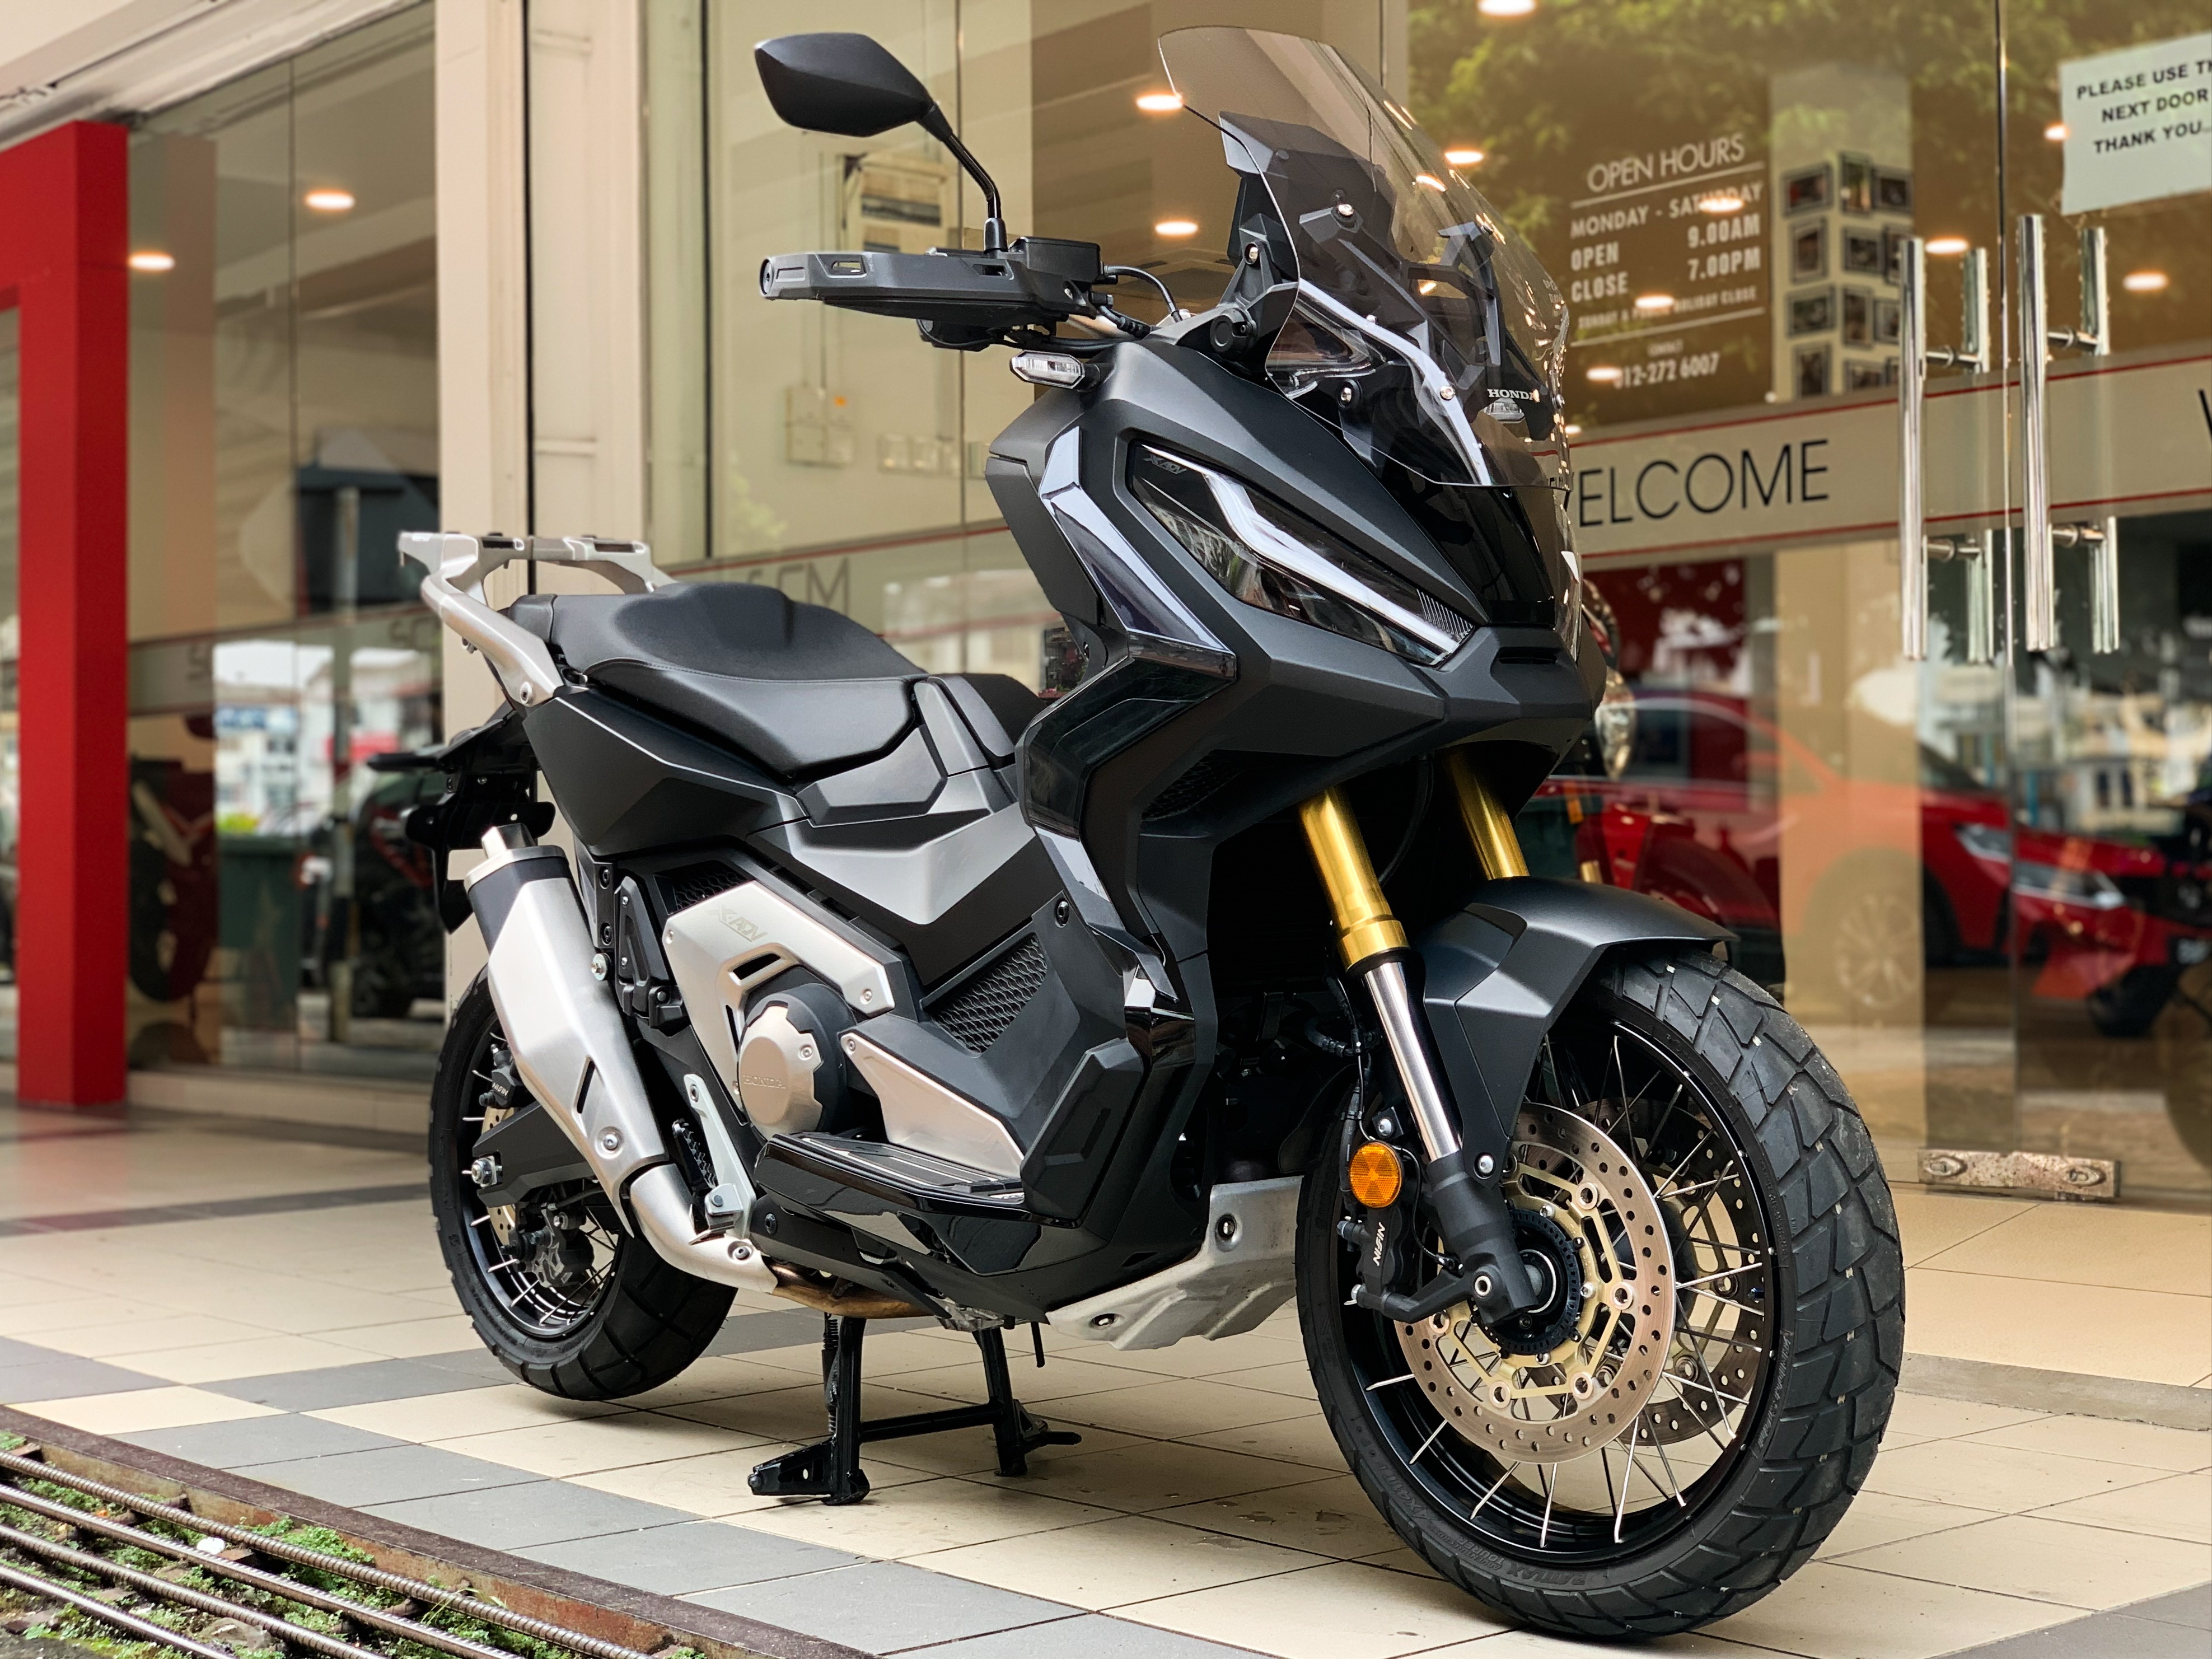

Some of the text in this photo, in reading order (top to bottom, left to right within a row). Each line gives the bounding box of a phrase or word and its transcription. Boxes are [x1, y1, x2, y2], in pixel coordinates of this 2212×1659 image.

[2077, 74, 2146, 100] PLEASE
[2153, 63, 2188, 83] USE
[2102, 88, 2208, 123] NEXT DOOR
[2094, 129, 2155, 153] THANK
[1587, 133, 1746, 193] OPEN HOURS
[1570, 204, 1649, 239] MONDAY
[1571, 213, 1760, 272] OPEN 9.00AM
[1571, 271, 1628, 303] CLOSE
[1687, 246, 1761, 281] 7.00PM
[1680, 351, 1720, 380] 6007
[1566, 440, 1828, 527] ELCOME
[743, 1075, 787, 1090] HONDA
